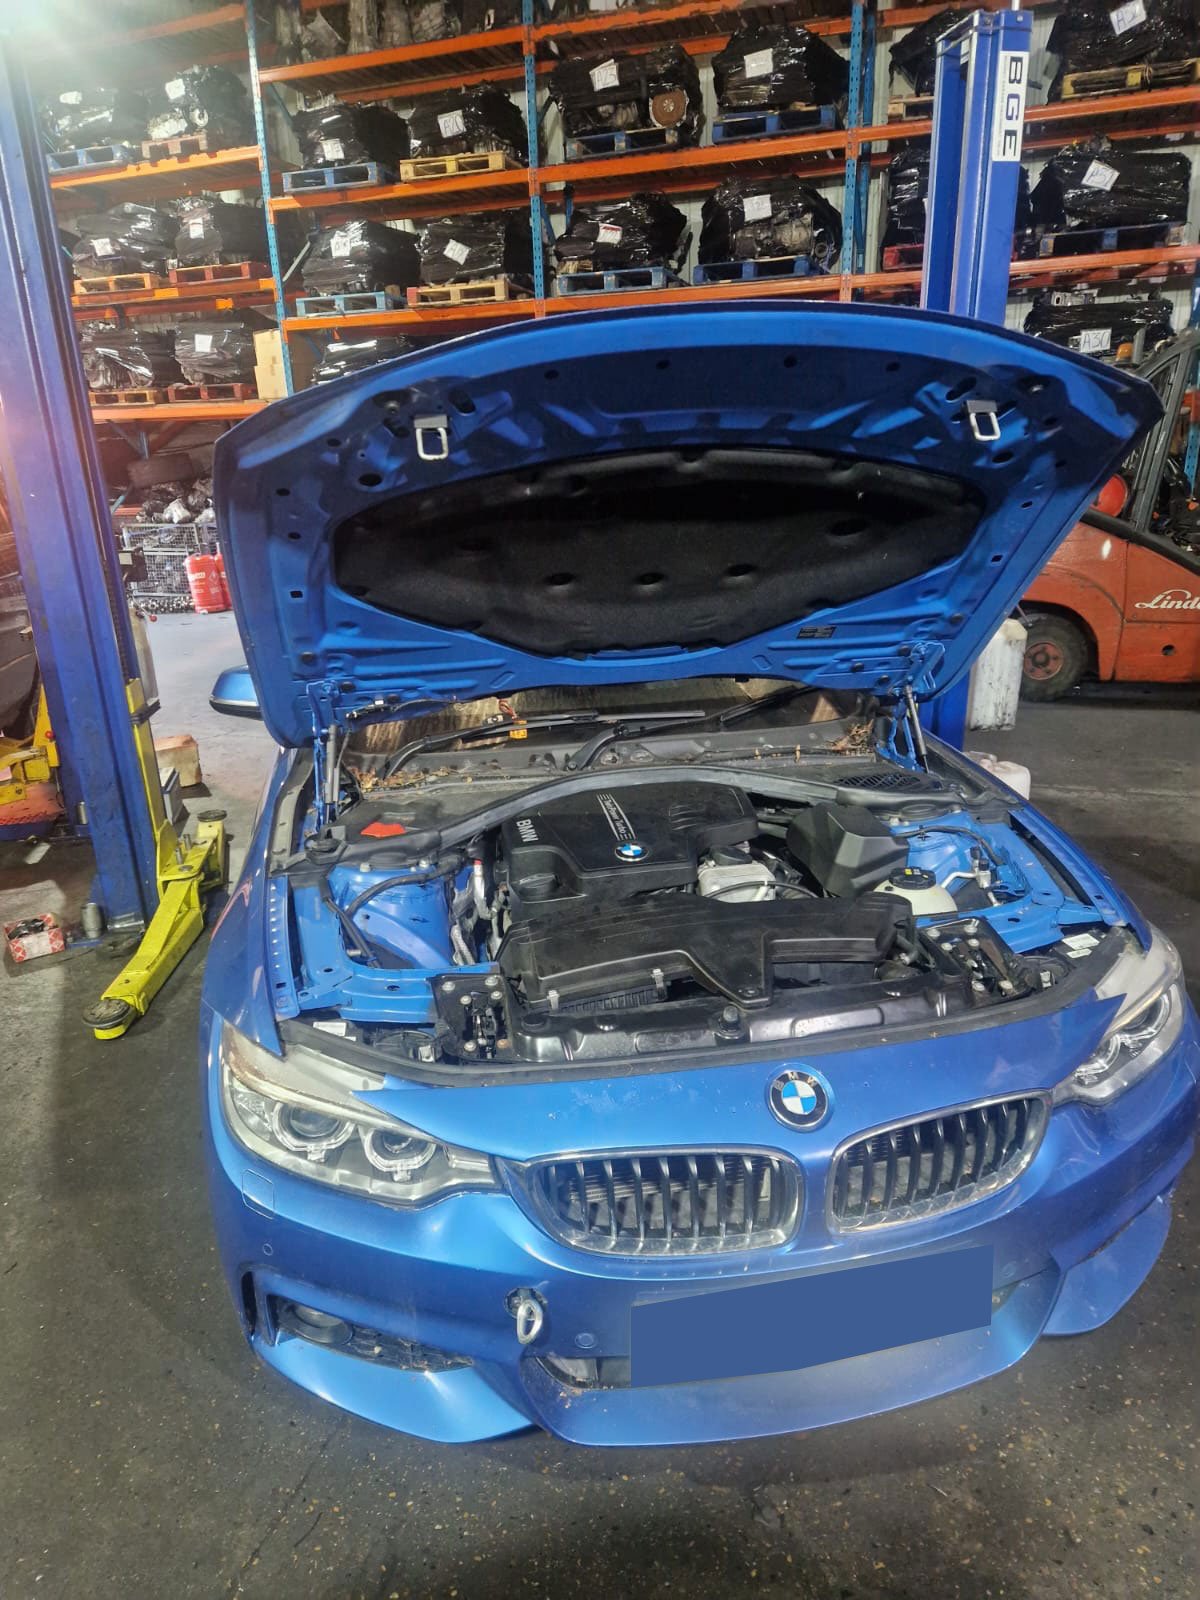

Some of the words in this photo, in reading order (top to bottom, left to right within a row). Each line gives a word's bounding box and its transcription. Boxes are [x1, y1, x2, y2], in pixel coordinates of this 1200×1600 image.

[1002, 55, 1024, 157] BGE
[516, 818, 539, 842] BMW
[773, 1071, 818, 1091] BMW
